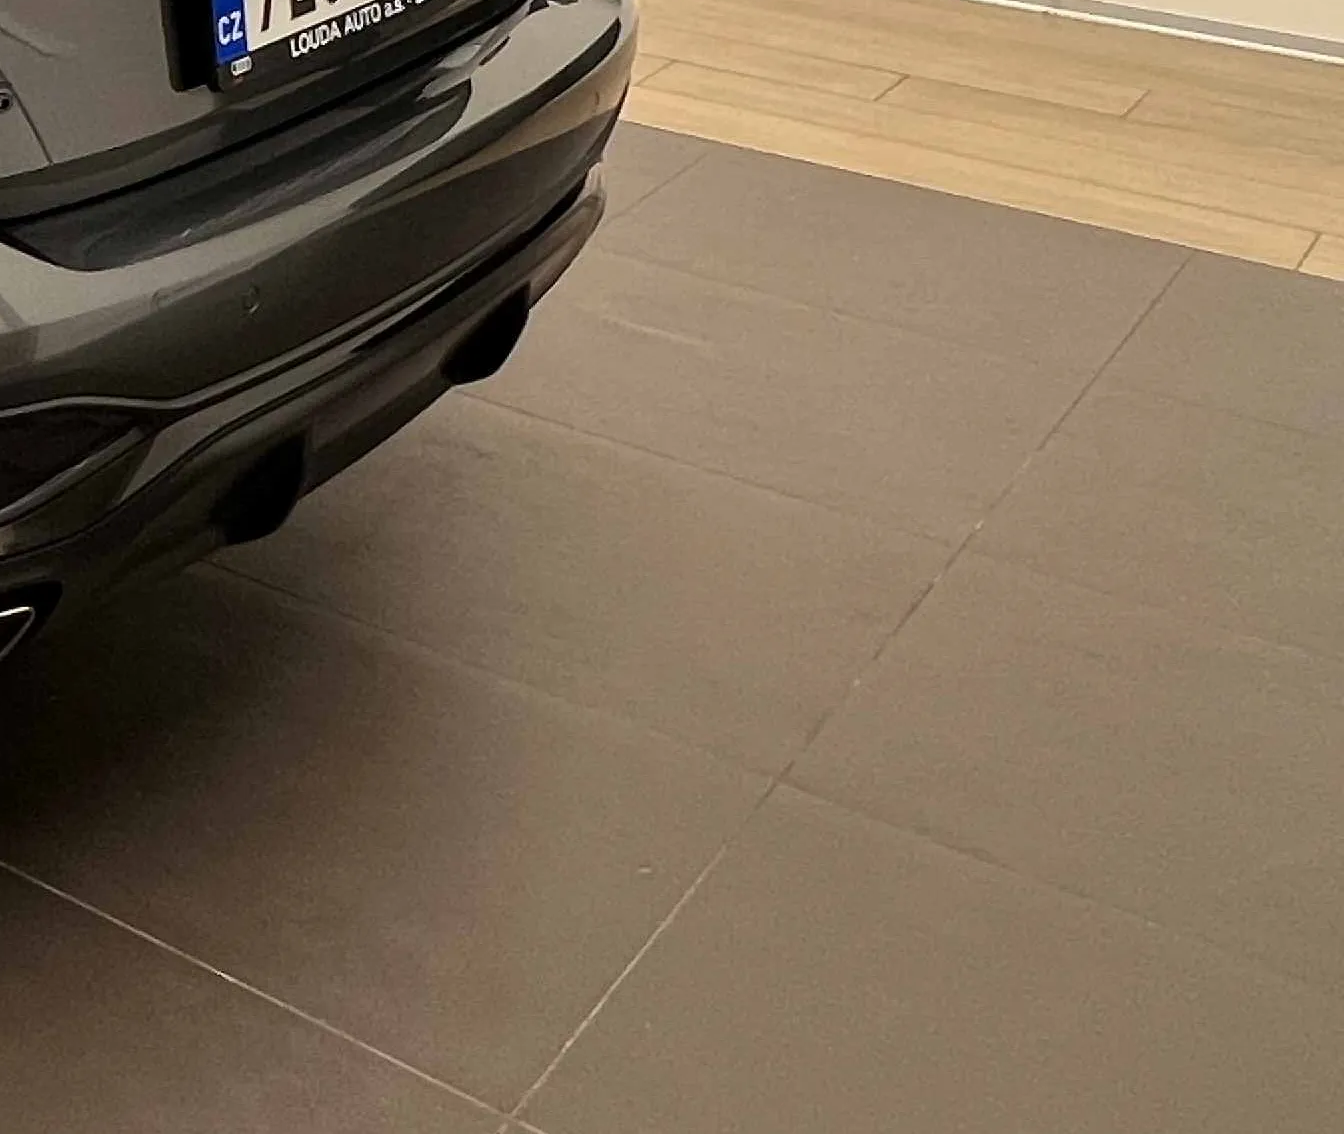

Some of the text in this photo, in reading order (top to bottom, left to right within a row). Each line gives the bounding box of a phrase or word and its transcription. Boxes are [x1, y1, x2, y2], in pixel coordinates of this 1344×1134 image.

[218, 11, 244, 46] CZ
[289, 21, 342, 58] LOUDA
[344, 2, 382, 35] AUTO
